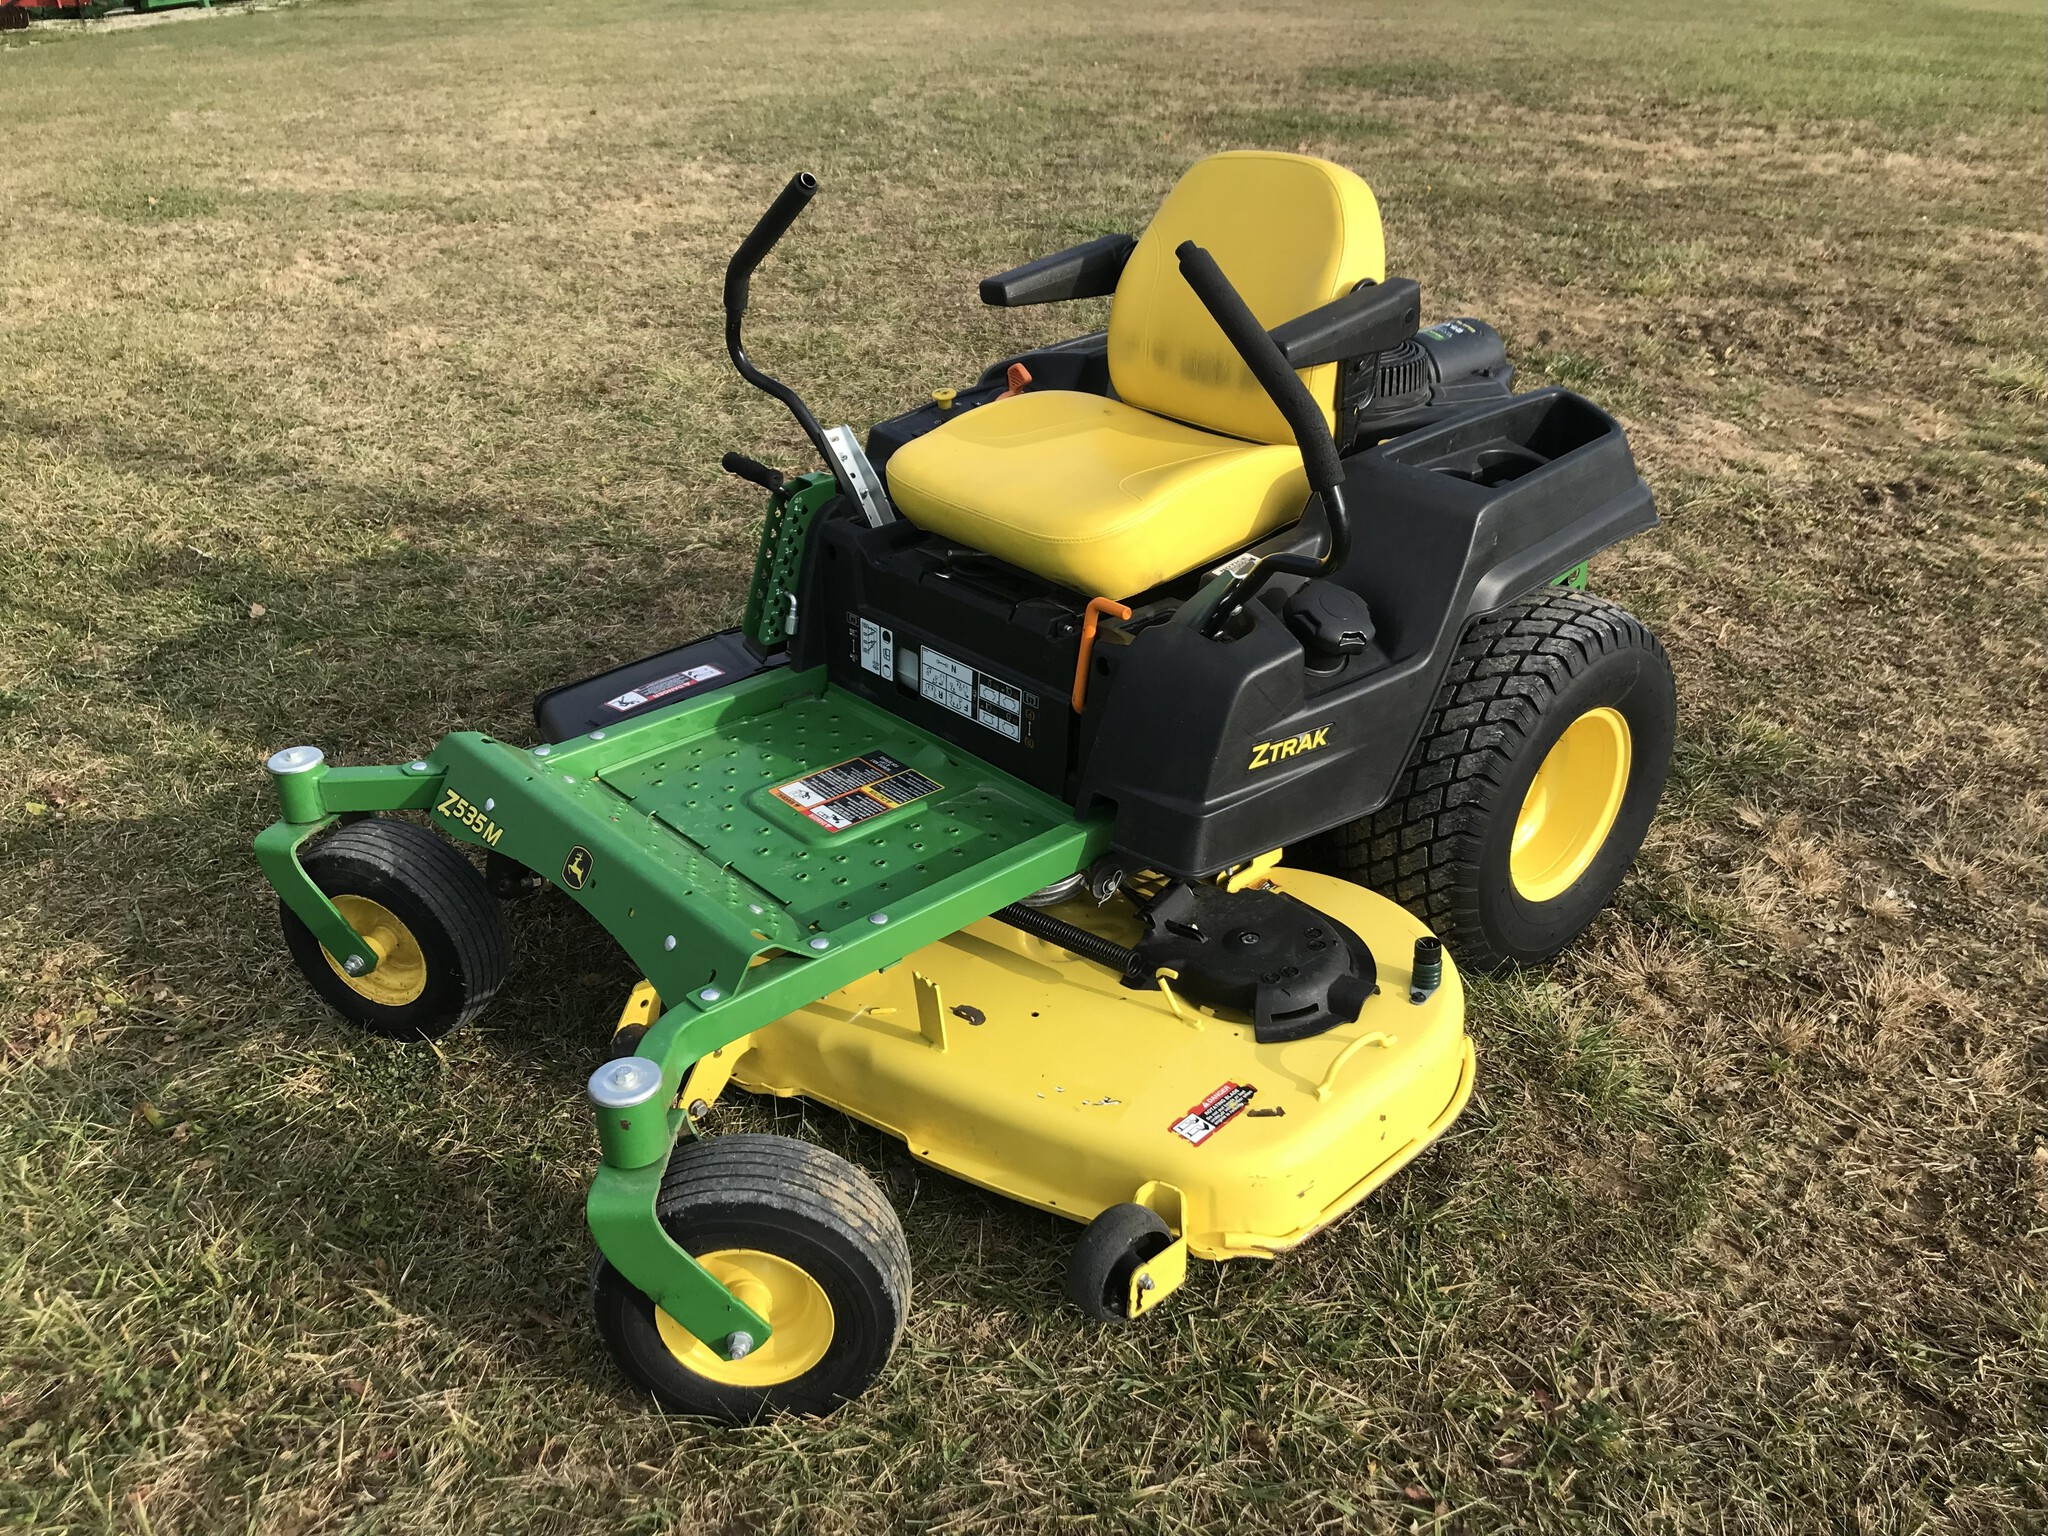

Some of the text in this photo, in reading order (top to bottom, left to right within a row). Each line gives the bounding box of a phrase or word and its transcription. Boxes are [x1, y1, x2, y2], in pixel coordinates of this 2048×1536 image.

[951, 665, 957, 674] N
[653, 685, 684, 698] DANGER
[938, 690, 943, 699] R
[964, 704, 969, 712] F
[1248, 727, 1330, 770] ZTRAK
[437, 788, 504, 847] Z535M
[1207, 1085, 1231, 1104] DANGER
[1204, 1098, 1226, 1116] ROTATING
